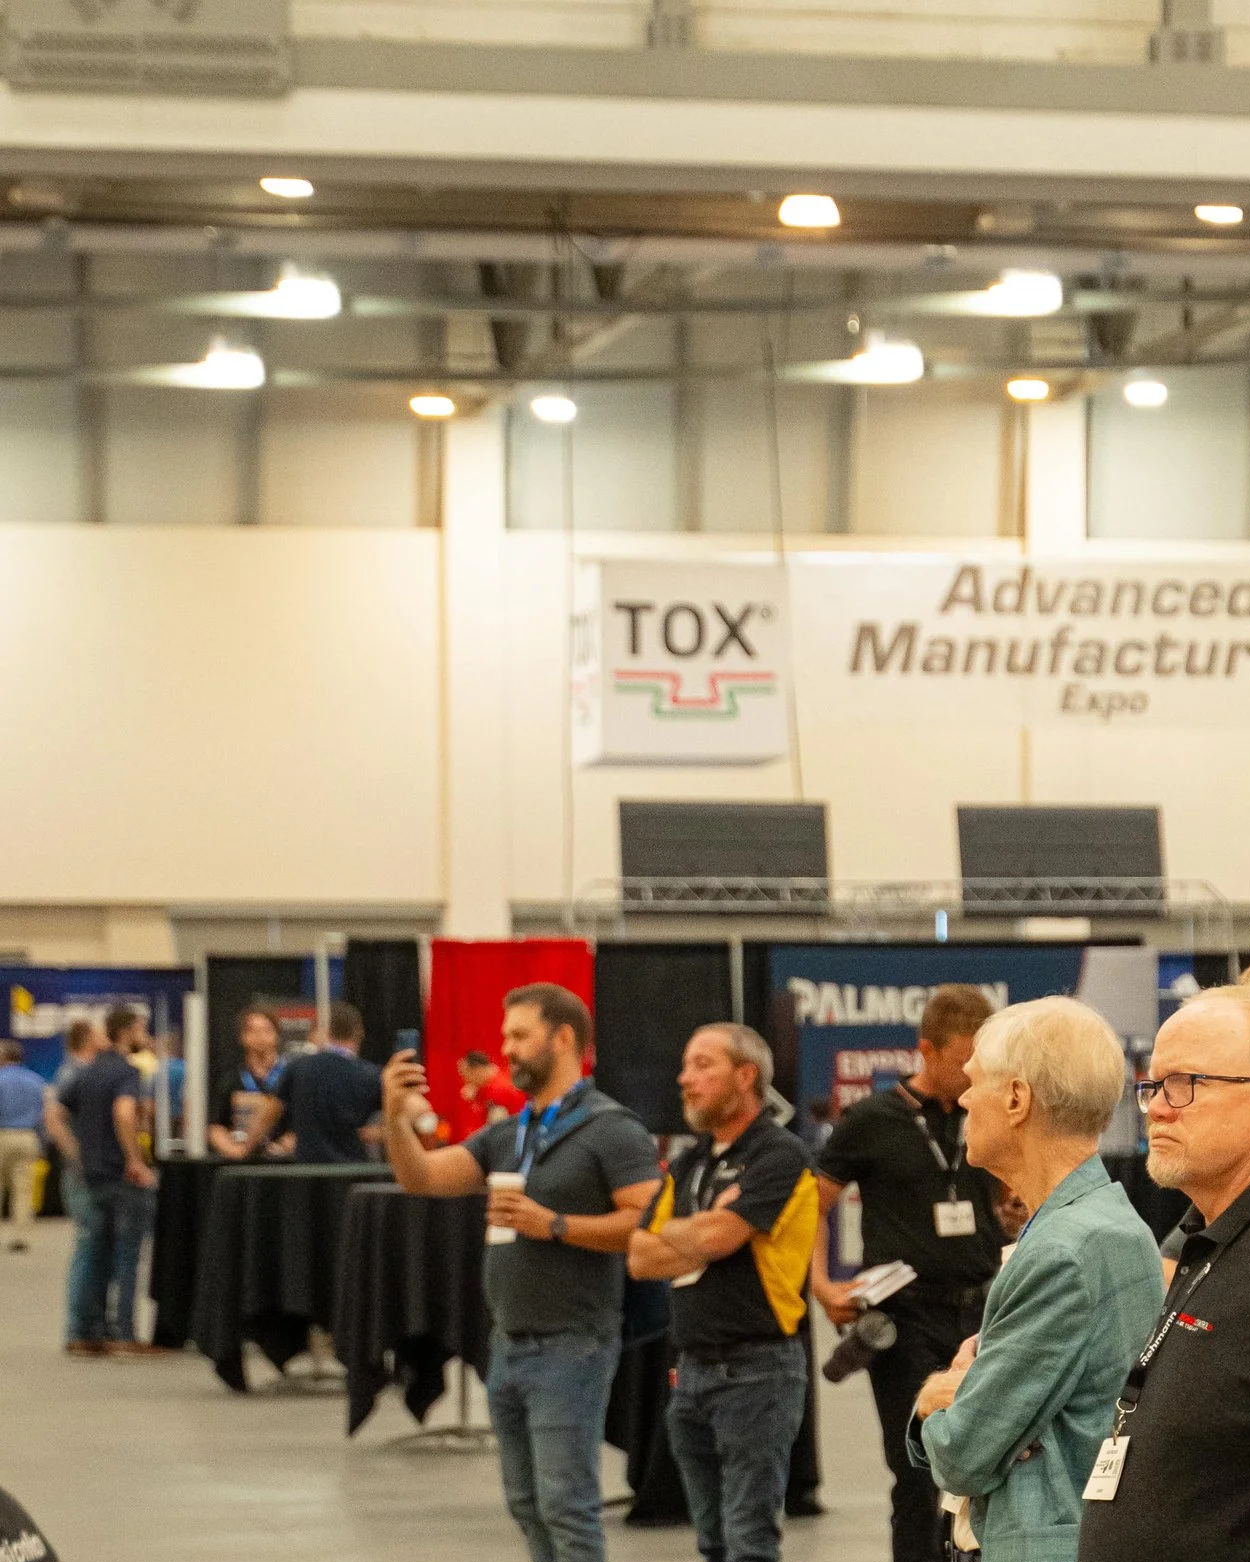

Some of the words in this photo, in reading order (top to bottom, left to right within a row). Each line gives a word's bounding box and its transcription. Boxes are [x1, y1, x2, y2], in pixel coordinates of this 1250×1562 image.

[1059, 682, 1150, 723] Expo
[787, 976, 1008, 1026] PALMGN
[1140, 1311, 1177, 1367] Rehmann
